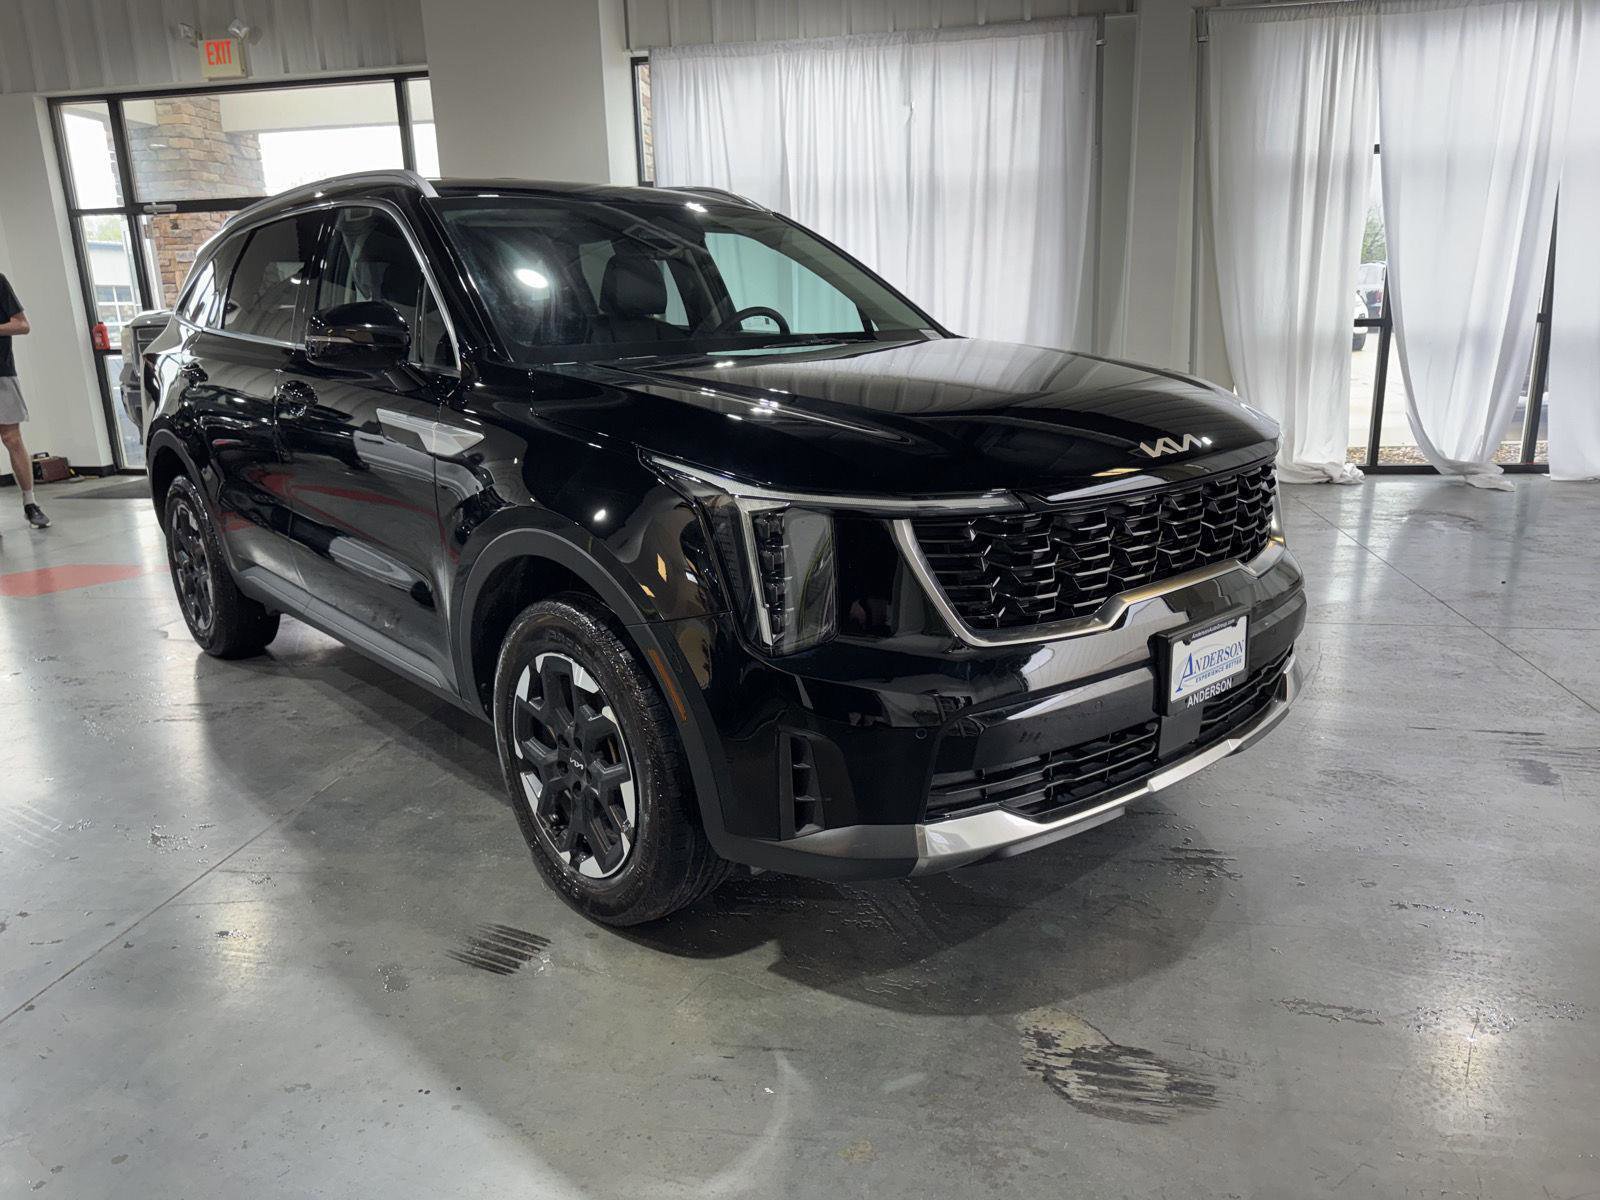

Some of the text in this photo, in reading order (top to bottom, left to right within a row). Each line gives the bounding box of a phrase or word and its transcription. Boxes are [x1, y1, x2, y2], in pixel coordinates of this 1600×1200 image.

[205, 40, 232, 65] EXIT
[1140, 434, 1202, 458] KIA
[1175, 640, 1244, 693] ANDERSON
[1195, 658, 1242, 683] EXPERIENCE BETTER
[1186, 678, 1233, 708] ANDERSON
